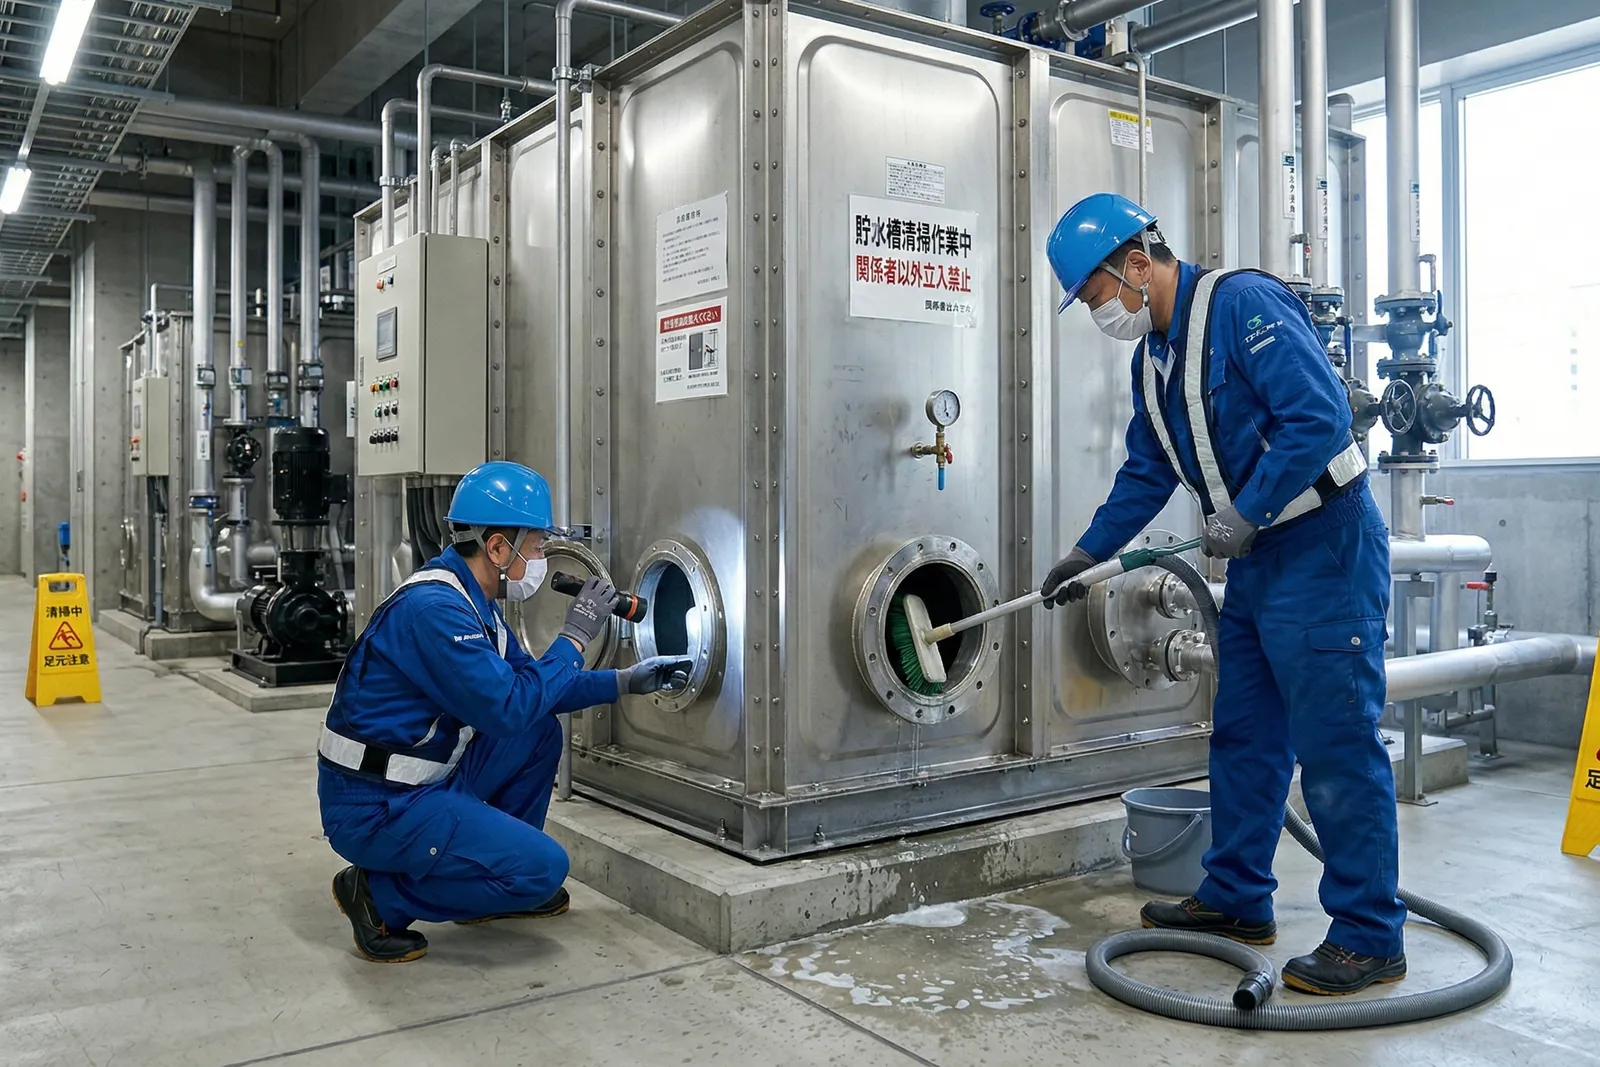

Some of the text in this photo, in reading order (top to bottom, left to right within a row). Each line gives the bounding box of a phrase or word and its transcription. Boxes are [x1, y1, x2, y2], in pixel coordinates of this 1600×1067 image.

[855, 214, 972, 259] 貯水槽清掃作業中
[856, 255, 972, 293] 関係者以外立入禁止
[46, 605, 83, 618] 清掃中
[44, 653, 90, 667] 足元注意
